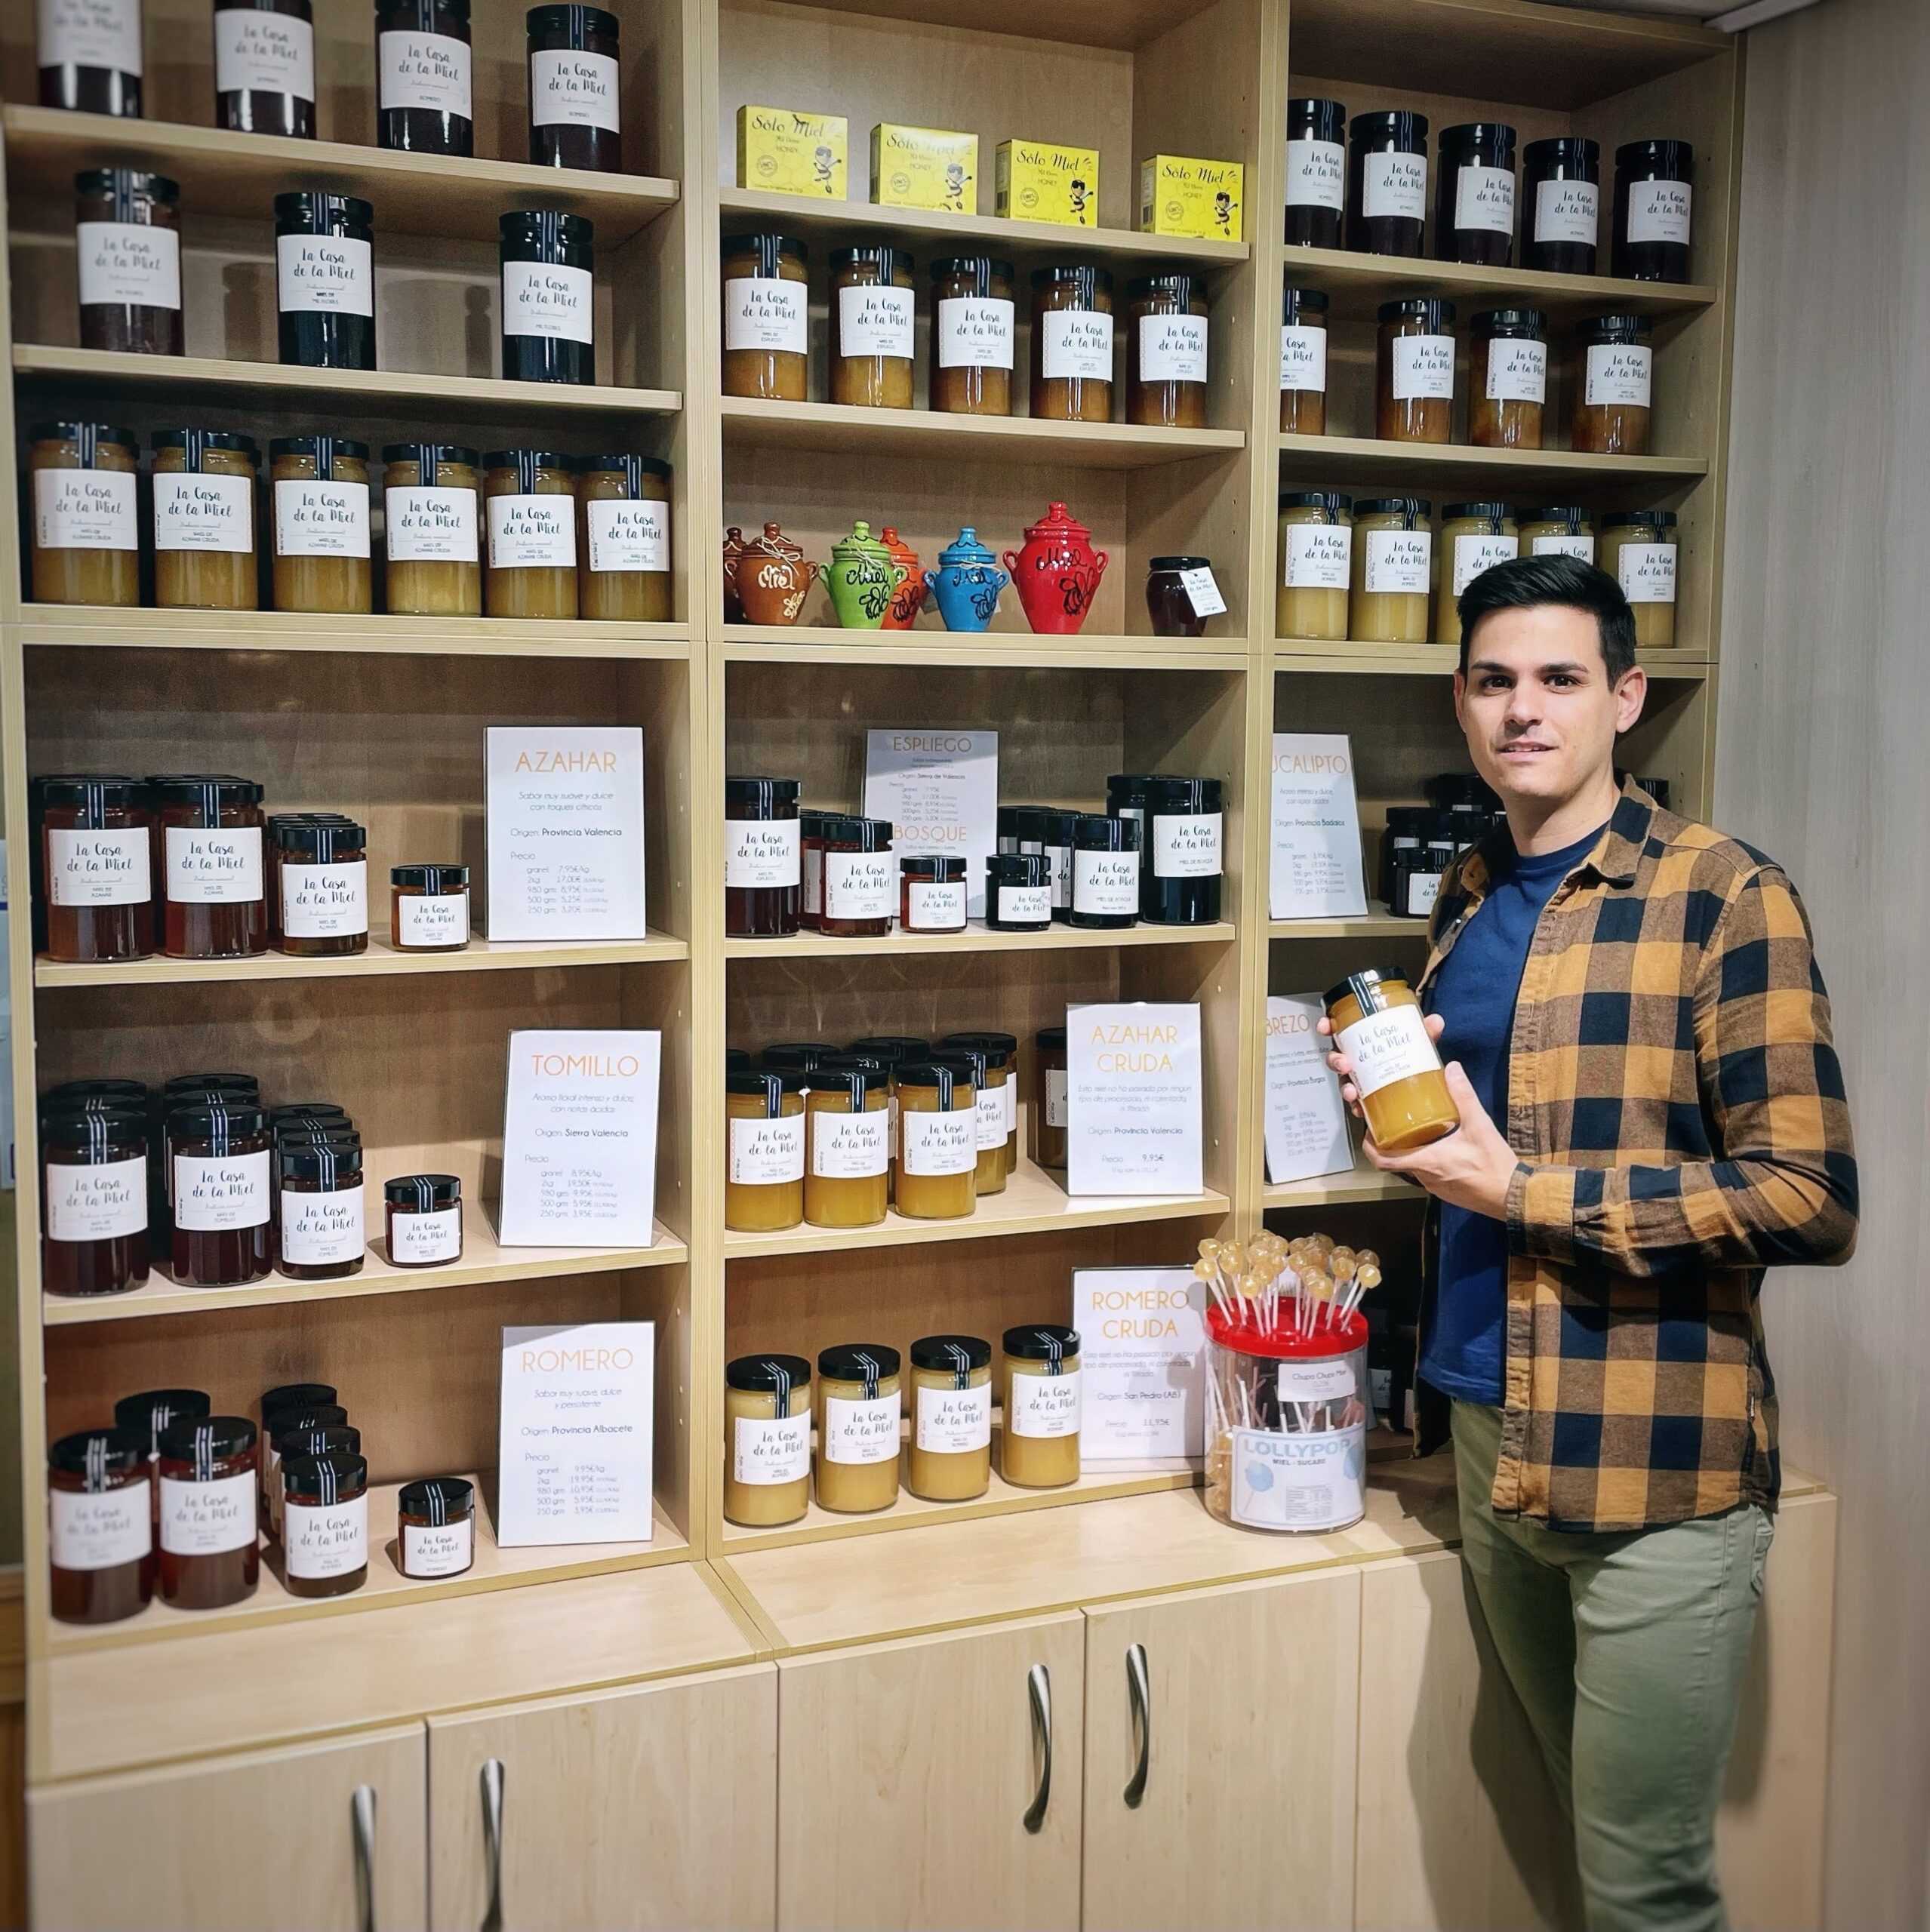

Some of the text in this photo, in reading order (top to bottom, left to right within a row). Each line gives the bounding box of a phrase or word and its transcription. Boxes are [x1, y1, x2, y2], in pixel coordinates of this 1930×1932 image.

[574, 63, 598, 78] Casa
[549, 78, 606, 96] de la Miel
[752, 115, 824, 137] Sólo Miel
[1017, 149, 1079, 171] Sólo Miel
[1162, 164, 1224, 183] Sólo Miel
[1670, 191, 1685, 203] Casa
[1648, 204, 1688, 217] de la Miel
[320, 248, 345, 263] Casa
[294, 263, 356, 280] de la Miel
[768, 290, 789, 304] Casa
[742, 305, 796, 320] de la Miel
[528, 507, 552, 520] Casa
[503, 521, 561, 535] de la Miel
[1408, 541, 1424, 552] Casa
[1385, 554, 1427, 566] de la Miel
[758, 565, 795, 590] Miel
[846, 564, 889, 586] Miel
[893, 737, 972, 752] ESPLIEGO
[515, 752, 617, 772] AZAHAR
[1273, 755, 1347, 774] UCALIPTO
[542, 828, 582, 836] Provincia
[584, 828, 622, 836] Valencia
[894, 826, 967, 843] BOSQUE
[1193, 825, 1211, 836] Casa
[1171, 838, 1217, 849] de la Miel
[322, 876, 347, 889] Casa
[296, 891, 356, 904] de la Miel
[1091, 1025, 1178, 1045] AZAHAR
[1373, 1025, 1399, 1038] Casa
[1359, 1032, 1412, 1063] de la Miel
[531, 1055, 639, 1077] TOMILLO
[1097, 1054, 1173, 1073] CRUDA
[565, 1128, 628, 1138] Sierra Valencia
[856, 1124, 876, 1136] Casa
[832, 1137, 881, 1149] de la Miel
[220, 1170, 246, 1182] Casa
[192, 1183, 254, 1198] de la Miel
[1092, 1291, 1190, 1311] ROMERO
[1102, 1319, 1179, 1339] CRUDA
[522, 1348, 633, 1372] ROMERO
[869, 1411, 887, 1422] Casa
[552, 1425, 633, 1435] Provincia Albacete
[844, 1421, 893, 1436] de la Miel
[436, 1536, 453, 1544] Casa
[417, 1543, 459, 1555] de la Miel
